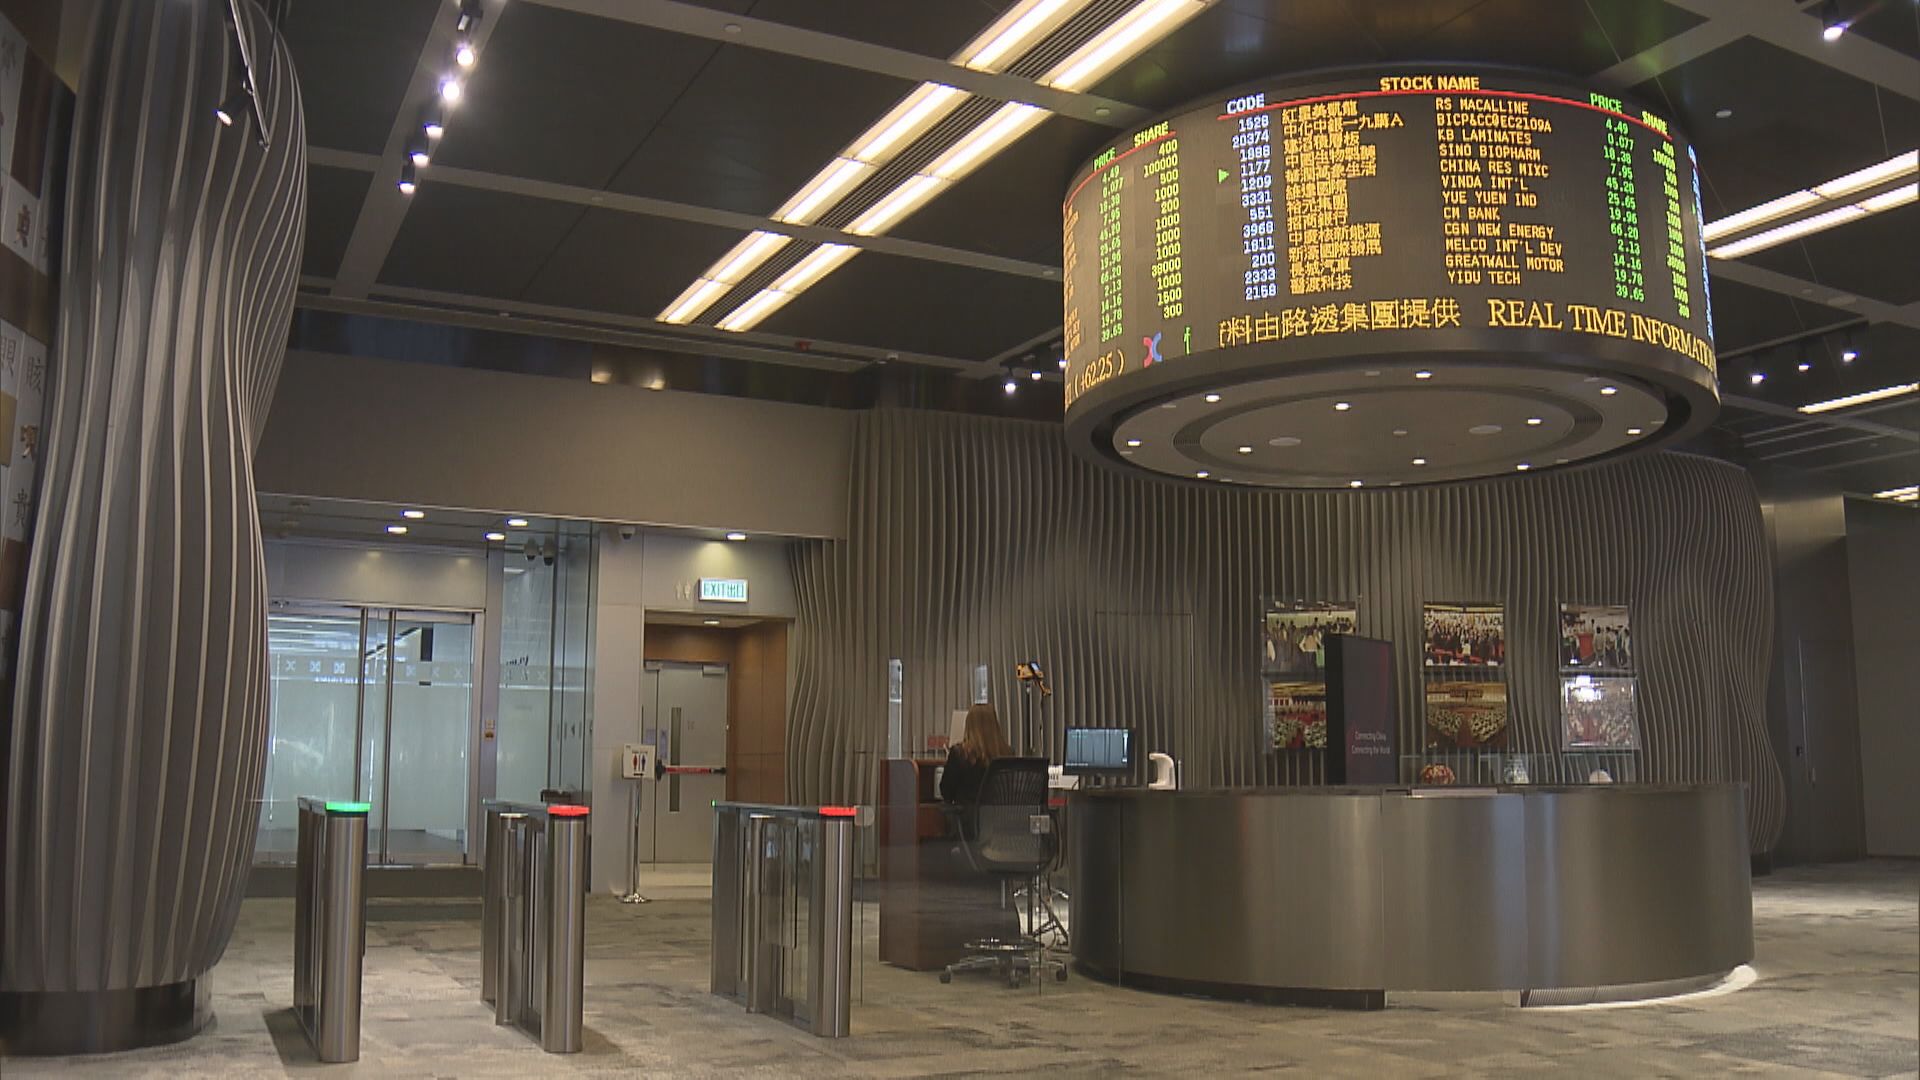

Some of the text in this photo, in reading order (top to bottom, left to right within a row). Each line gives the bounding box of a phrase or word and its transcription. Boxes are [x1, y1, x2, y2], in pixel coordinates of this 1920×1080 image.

[1380, 76, 1480, 91] STOCK NAME
[1227, 93, 1265, 114] CODE
[1436, 97, 1530, 114] RS MACALLINE
[1590, 93, 1622, 114] PRICE
[1134, 121, 1168, 147] SHARE
[1606, 118, 1628, 135] 4.49
[1232, 130, 1270, 149] 20374
[1438, 129, 1532, 146] KB LAMINATES
[1607, 132, 1634, 151] 0.077
[1159, 139, 1178, 156] 400
[1439, 144, 1541, 162] SINO BIOPHARM
[1093, 147, 1116, 171] PRICE
[1144, 155, 1178, 178] 100000
[1102, 165, 1120, 184] 4.49
[1240, 160, 1271, 177] 1177
[1440, 159, 1550, 178] CHINA RES MIXC
[1610, 163, 1633, 180] 7.95
[1160, 170, 1178, 185] 500
[1241, 175, 1272, 192] 1209
[1442, 175, 1528, 190] VINDA INT'L
[1103, 177, 1124, 198] 0.077
[1155, 184, 1178, 202] 1000
[1161, 198, 1179, 214] 200
[1242, 190, 1272, 207] 3331
[1442, 191, 1538, 208] YUE YUEN IND
[1608, 192, 1636, 210] 25.65
[1156, 214, 1180, 230] 1000
[1288, 210, 1348, 232] 招商銀行
[1444, 206, 1501, 221] CM BANK
[1156, 228, 1180, 246] 1000
[1444, 222, 1554, 240] CGN NEW ENERGY
[1610, 223, 1638, 240] 66.20
[1156, 243, 1180, 260] 1000
[1244, 236, 1274, 254] 1811
[1446, 238, 1562, 256] MELCO INT'L DEV
[1617, 239, 1640, 255] 2.13
[1152, 258, 1181, 278] 38000
[1252, 252, 1275, 268] 200
[1446, 254, 1564, 273] GREATWALL MOTOR
[1613, 253, 1642, 270] 14.16
[1157, 274, 1182, 290] 1000
[1244, 268, 1276, 285] 2333
[1448, 270, 1521, 285] YIDU TECH
[1104, 280, 1122, 296] 2.13
[1616, 284, 1645, 302] 39.65
[1158, 288, 1182, 306] 1500
[1164, 303, 1182, 320] 300
[1488, 299, 1564, 330] REAL
[1567, 304, 1628, 338] TIME
